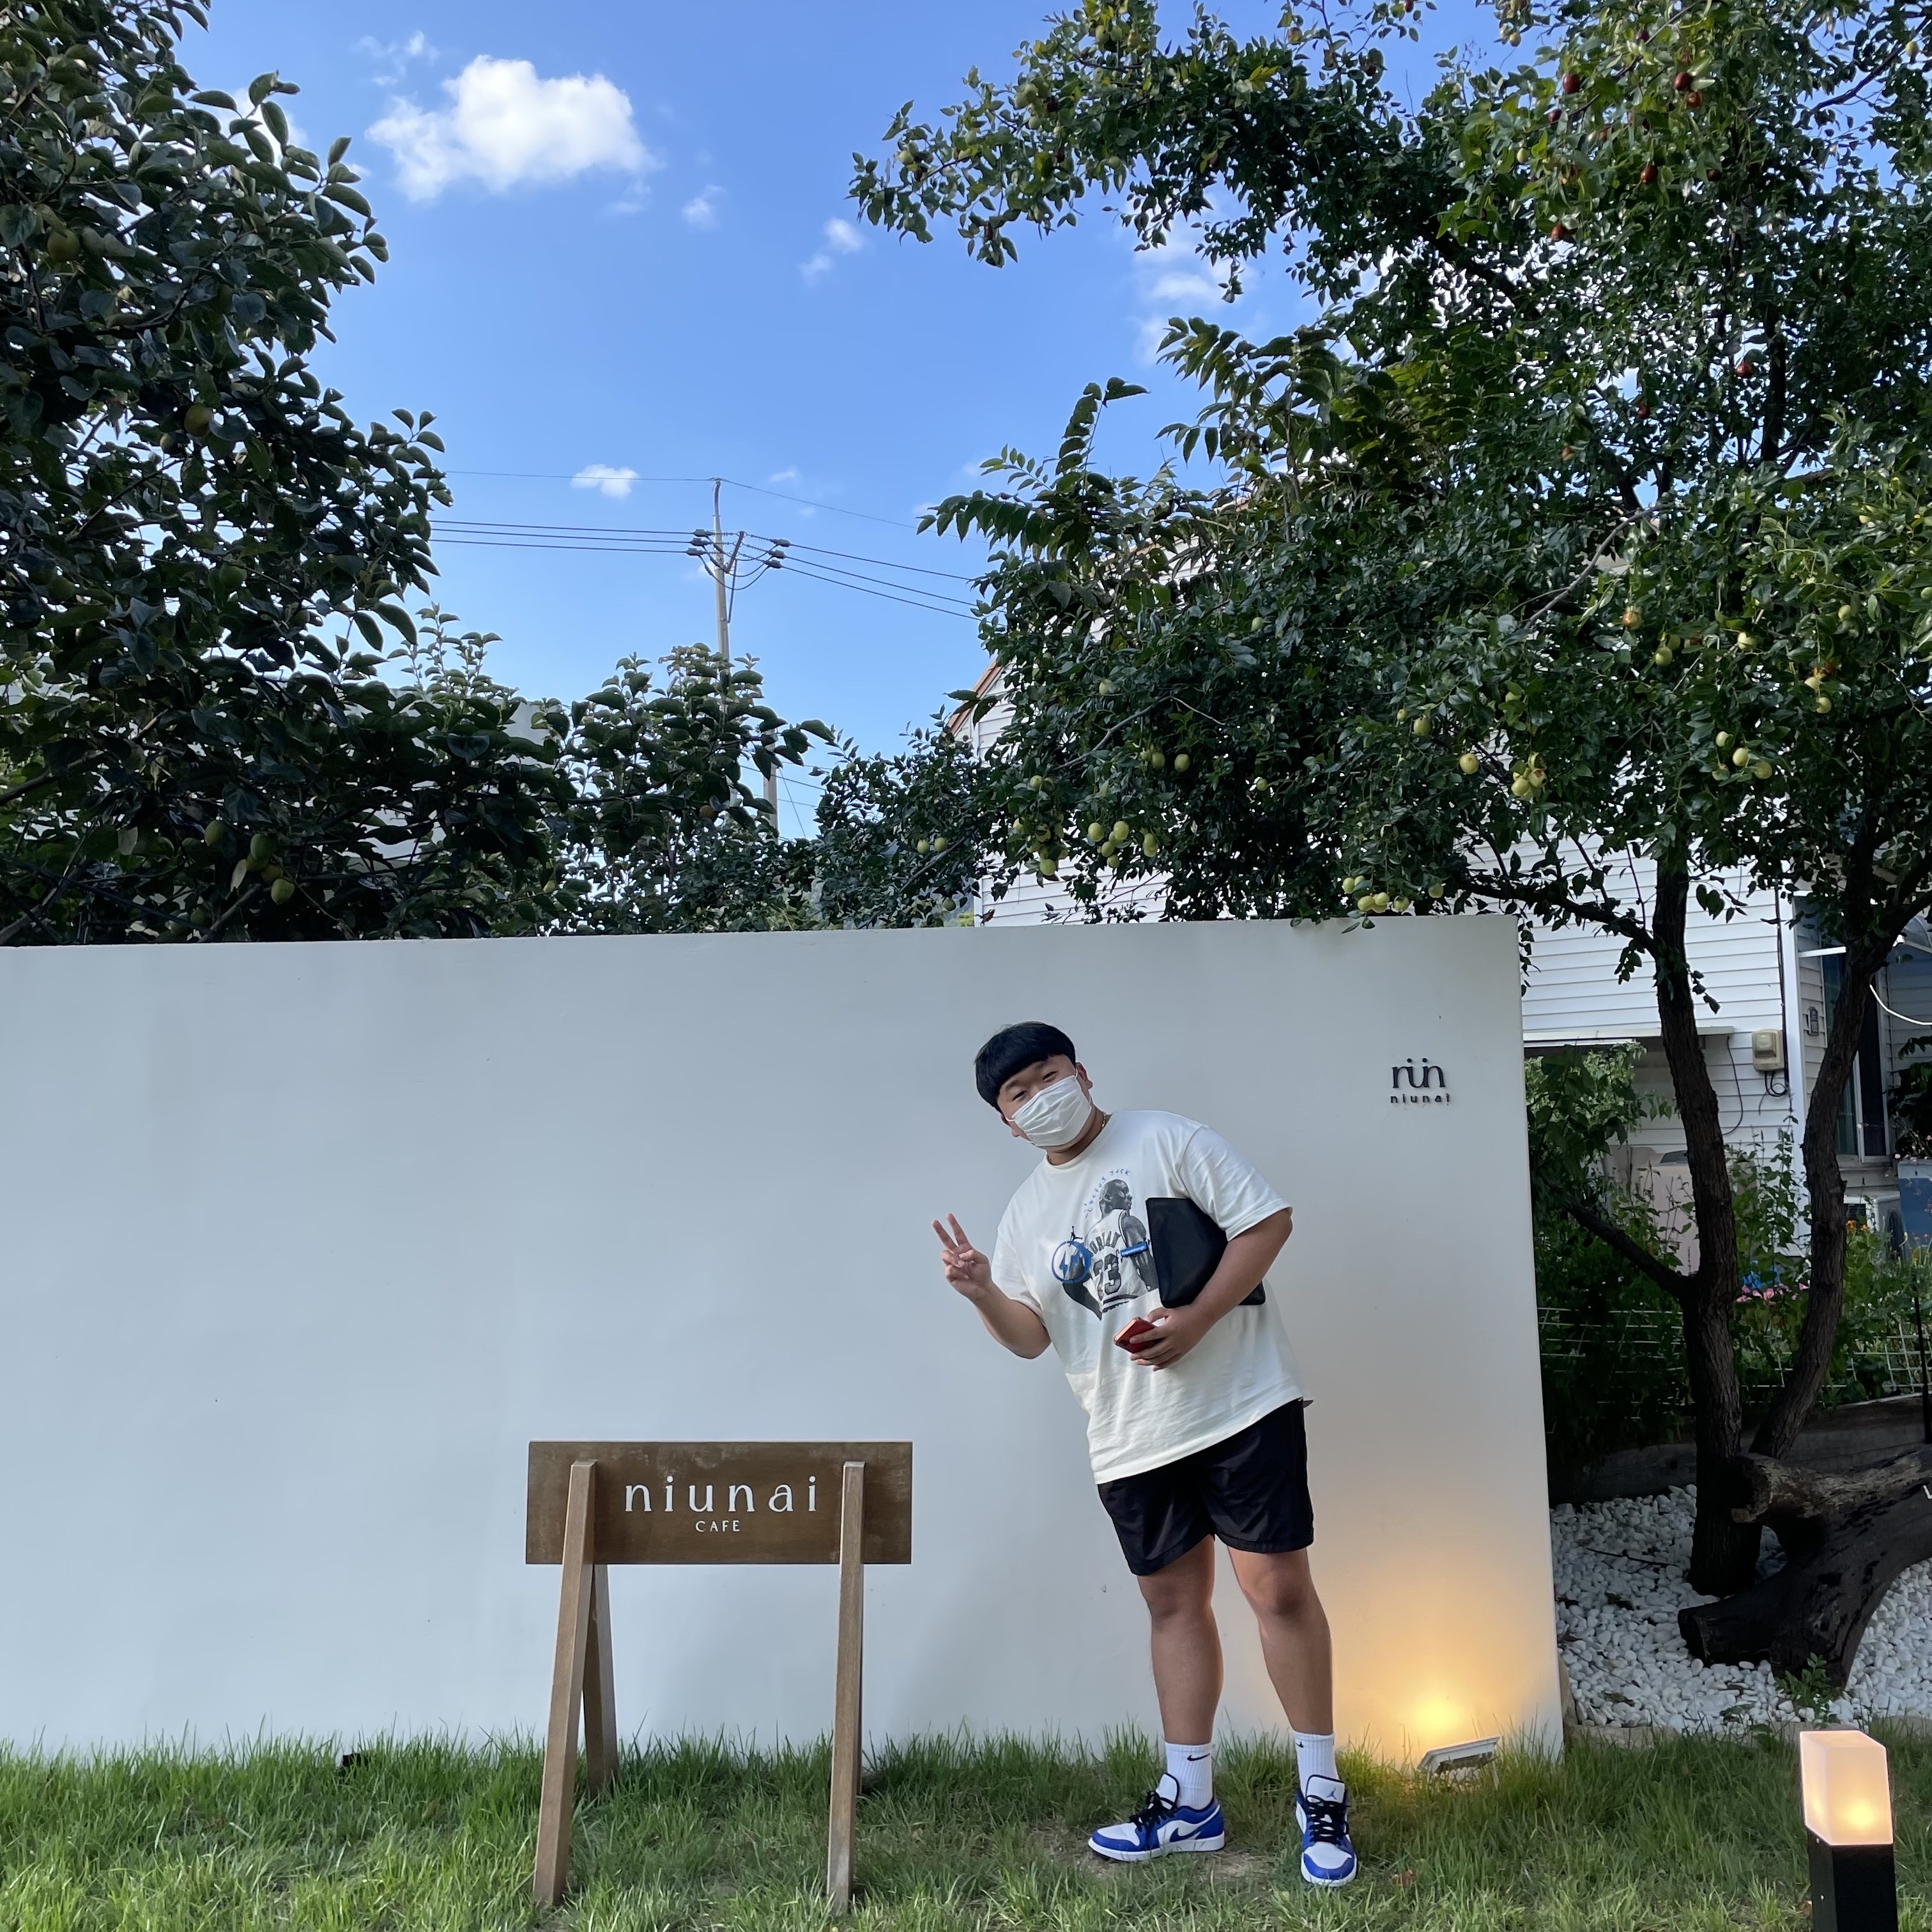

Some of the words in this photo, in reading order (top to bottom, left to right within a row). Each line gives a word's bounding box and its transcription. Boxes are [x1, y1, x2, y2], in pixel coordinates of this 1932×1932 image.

[1390, 1093, 1450, 1104] niunai
[1092, 1253, 1121, 1301] 23
[624, 1475, 817, 1513] niunai
[695, 1520, 741, 1533] CAFE
